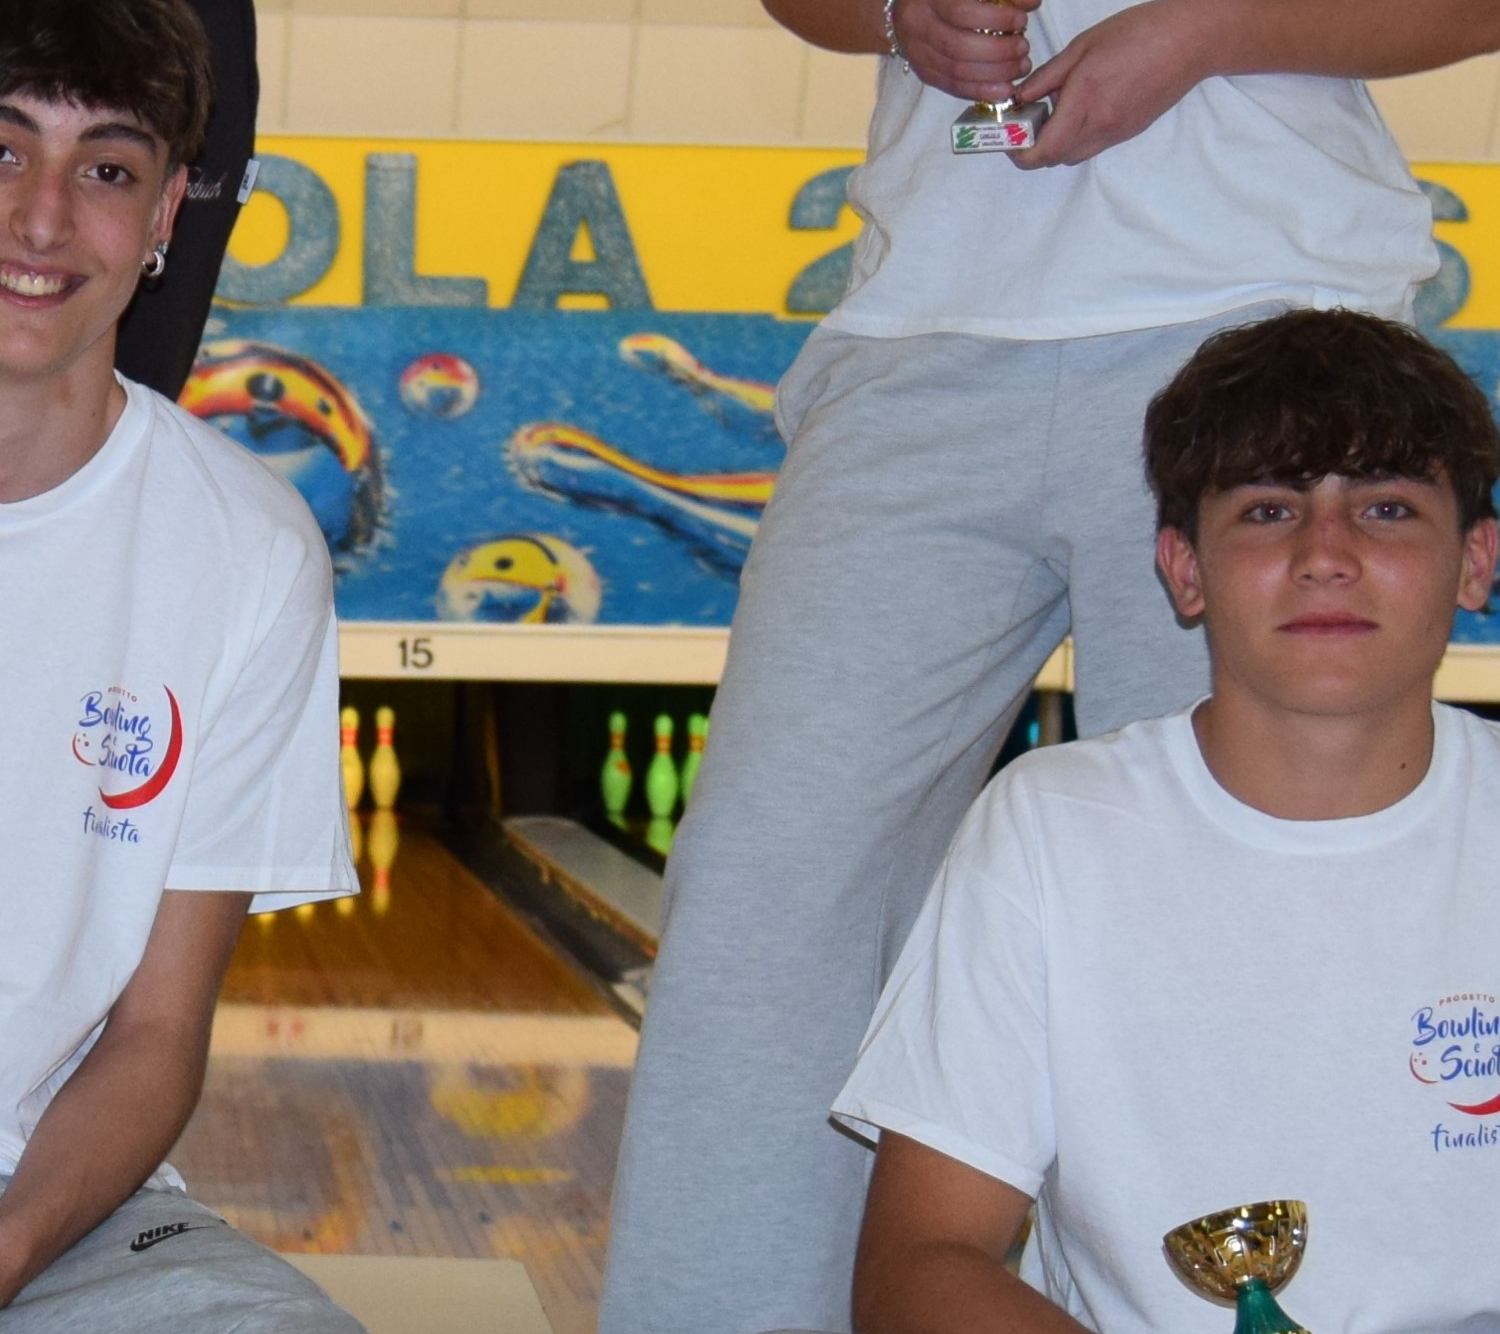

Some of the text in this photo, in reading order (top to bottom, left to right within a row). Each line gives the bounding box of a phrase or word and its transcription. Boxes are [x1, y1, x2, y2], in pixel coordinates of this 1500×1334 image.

[399, 638, 434, 669] 15
[1438, 993, 1496, 1007] PROGETTO
[137, 1222, 190, 1244] NIKE
